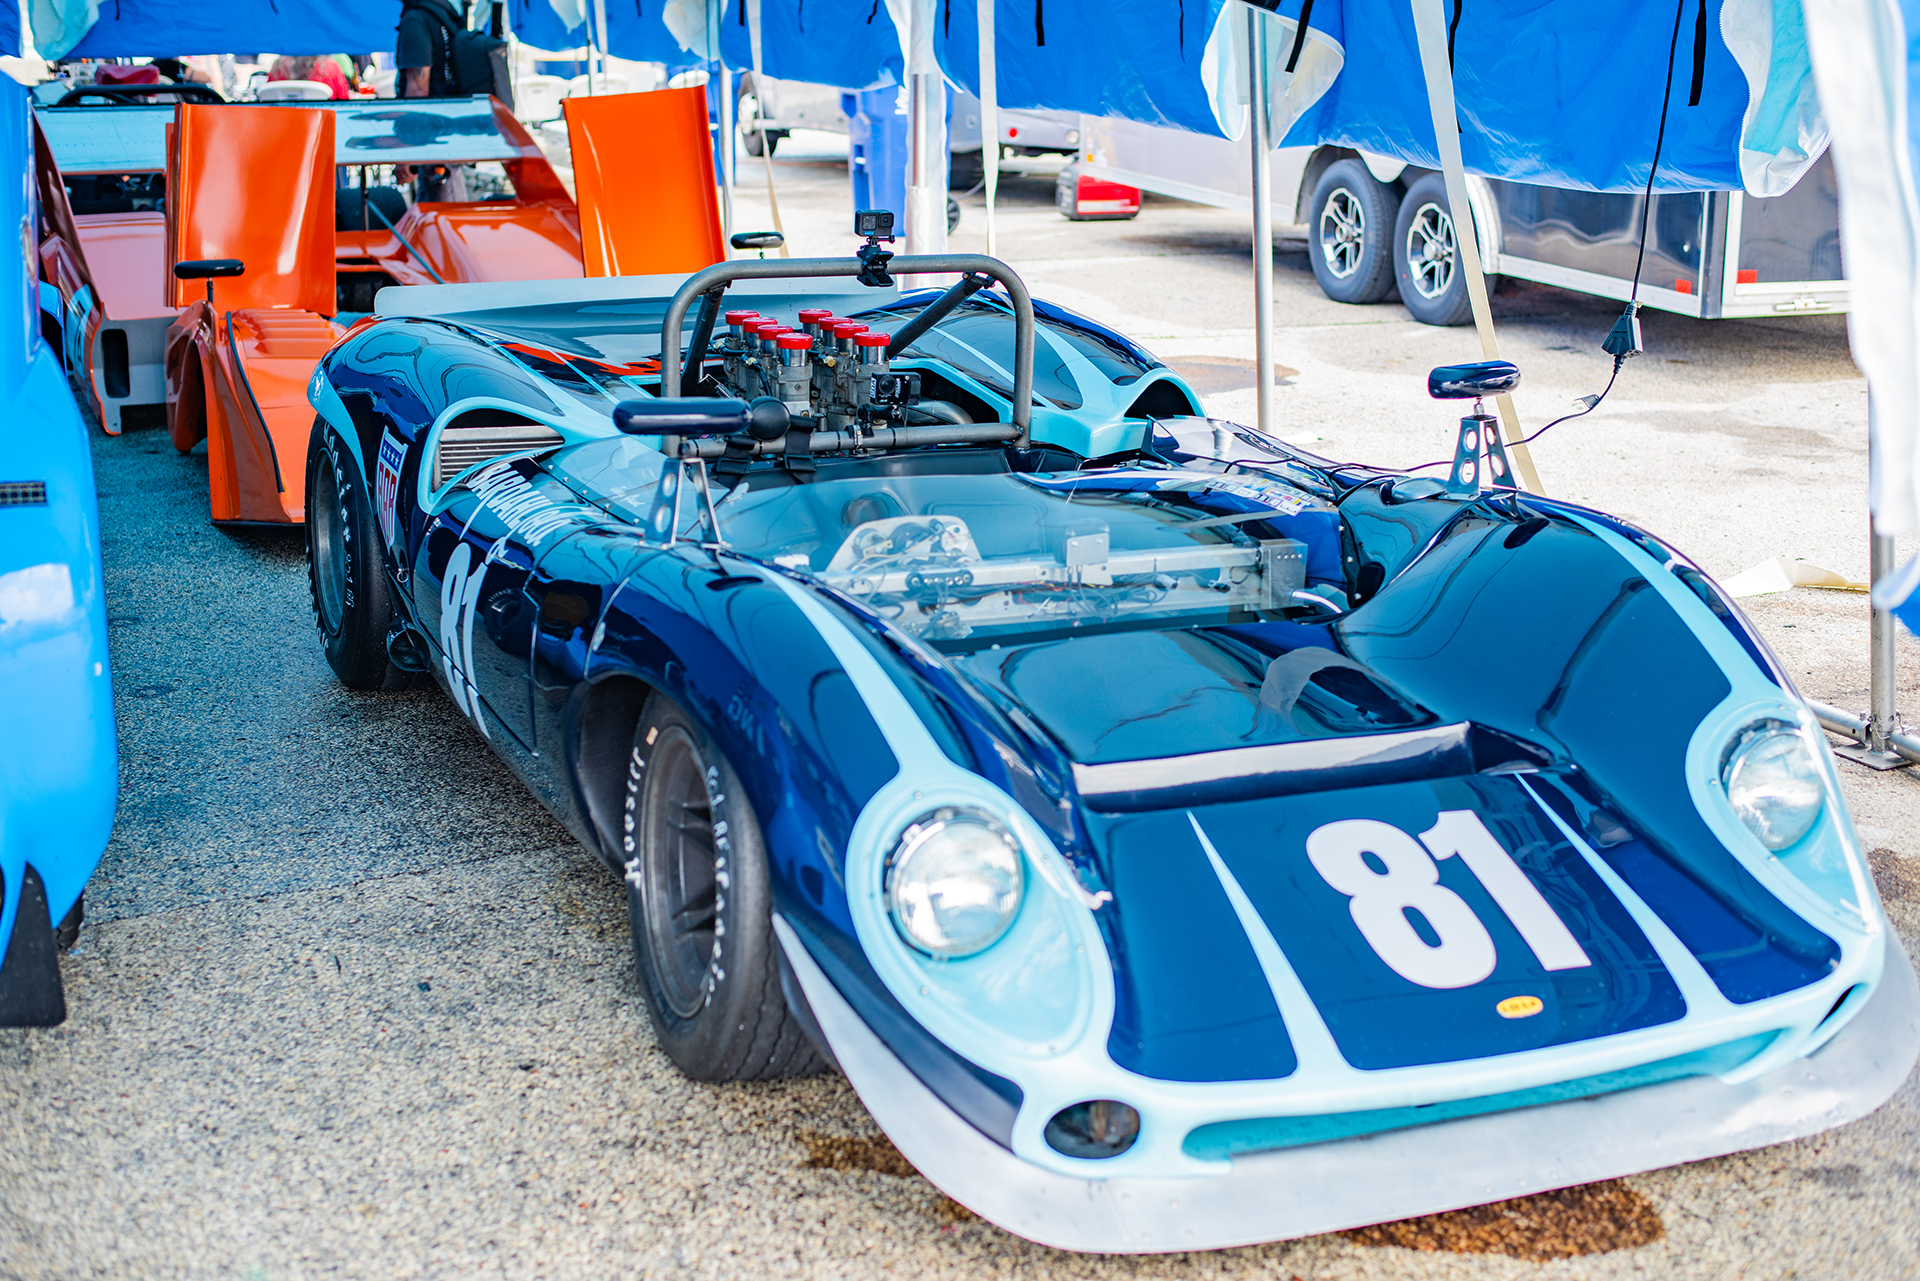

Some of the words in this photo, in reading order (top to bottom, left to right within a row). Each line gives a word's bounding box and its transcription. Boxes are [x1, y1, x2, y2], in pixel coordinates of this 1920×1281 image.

[459, 462, 554, 541] BARDAHL
[440, 542, 492, 739] 81
[1306, 809, 1592, 989] 81
